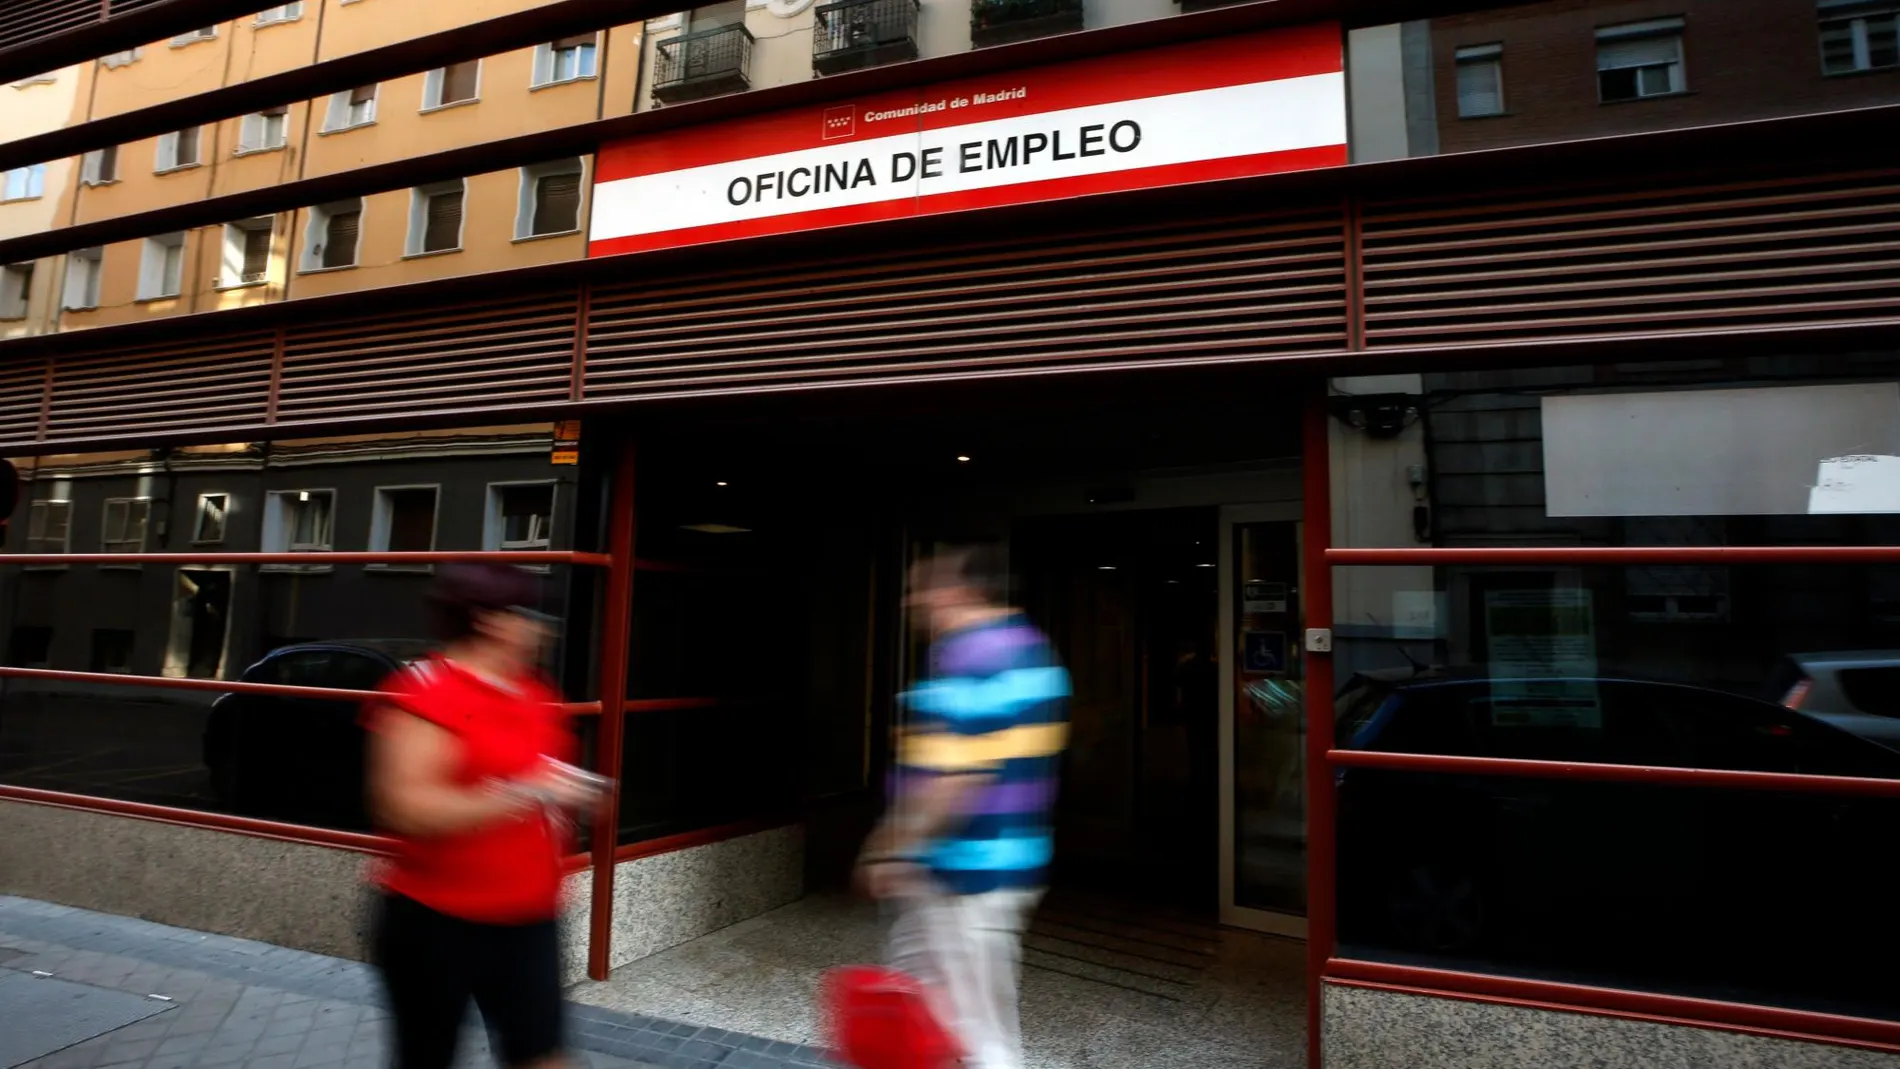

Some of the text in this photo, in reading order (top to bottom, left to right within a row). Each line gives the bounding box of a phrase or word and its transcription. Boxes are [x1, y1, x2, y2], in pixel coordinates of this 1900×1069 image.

[864, 87, 1027, 122] Comunidad de Madrid
[727, 119, 1142, 206] OFICINA DE EMPLEO
